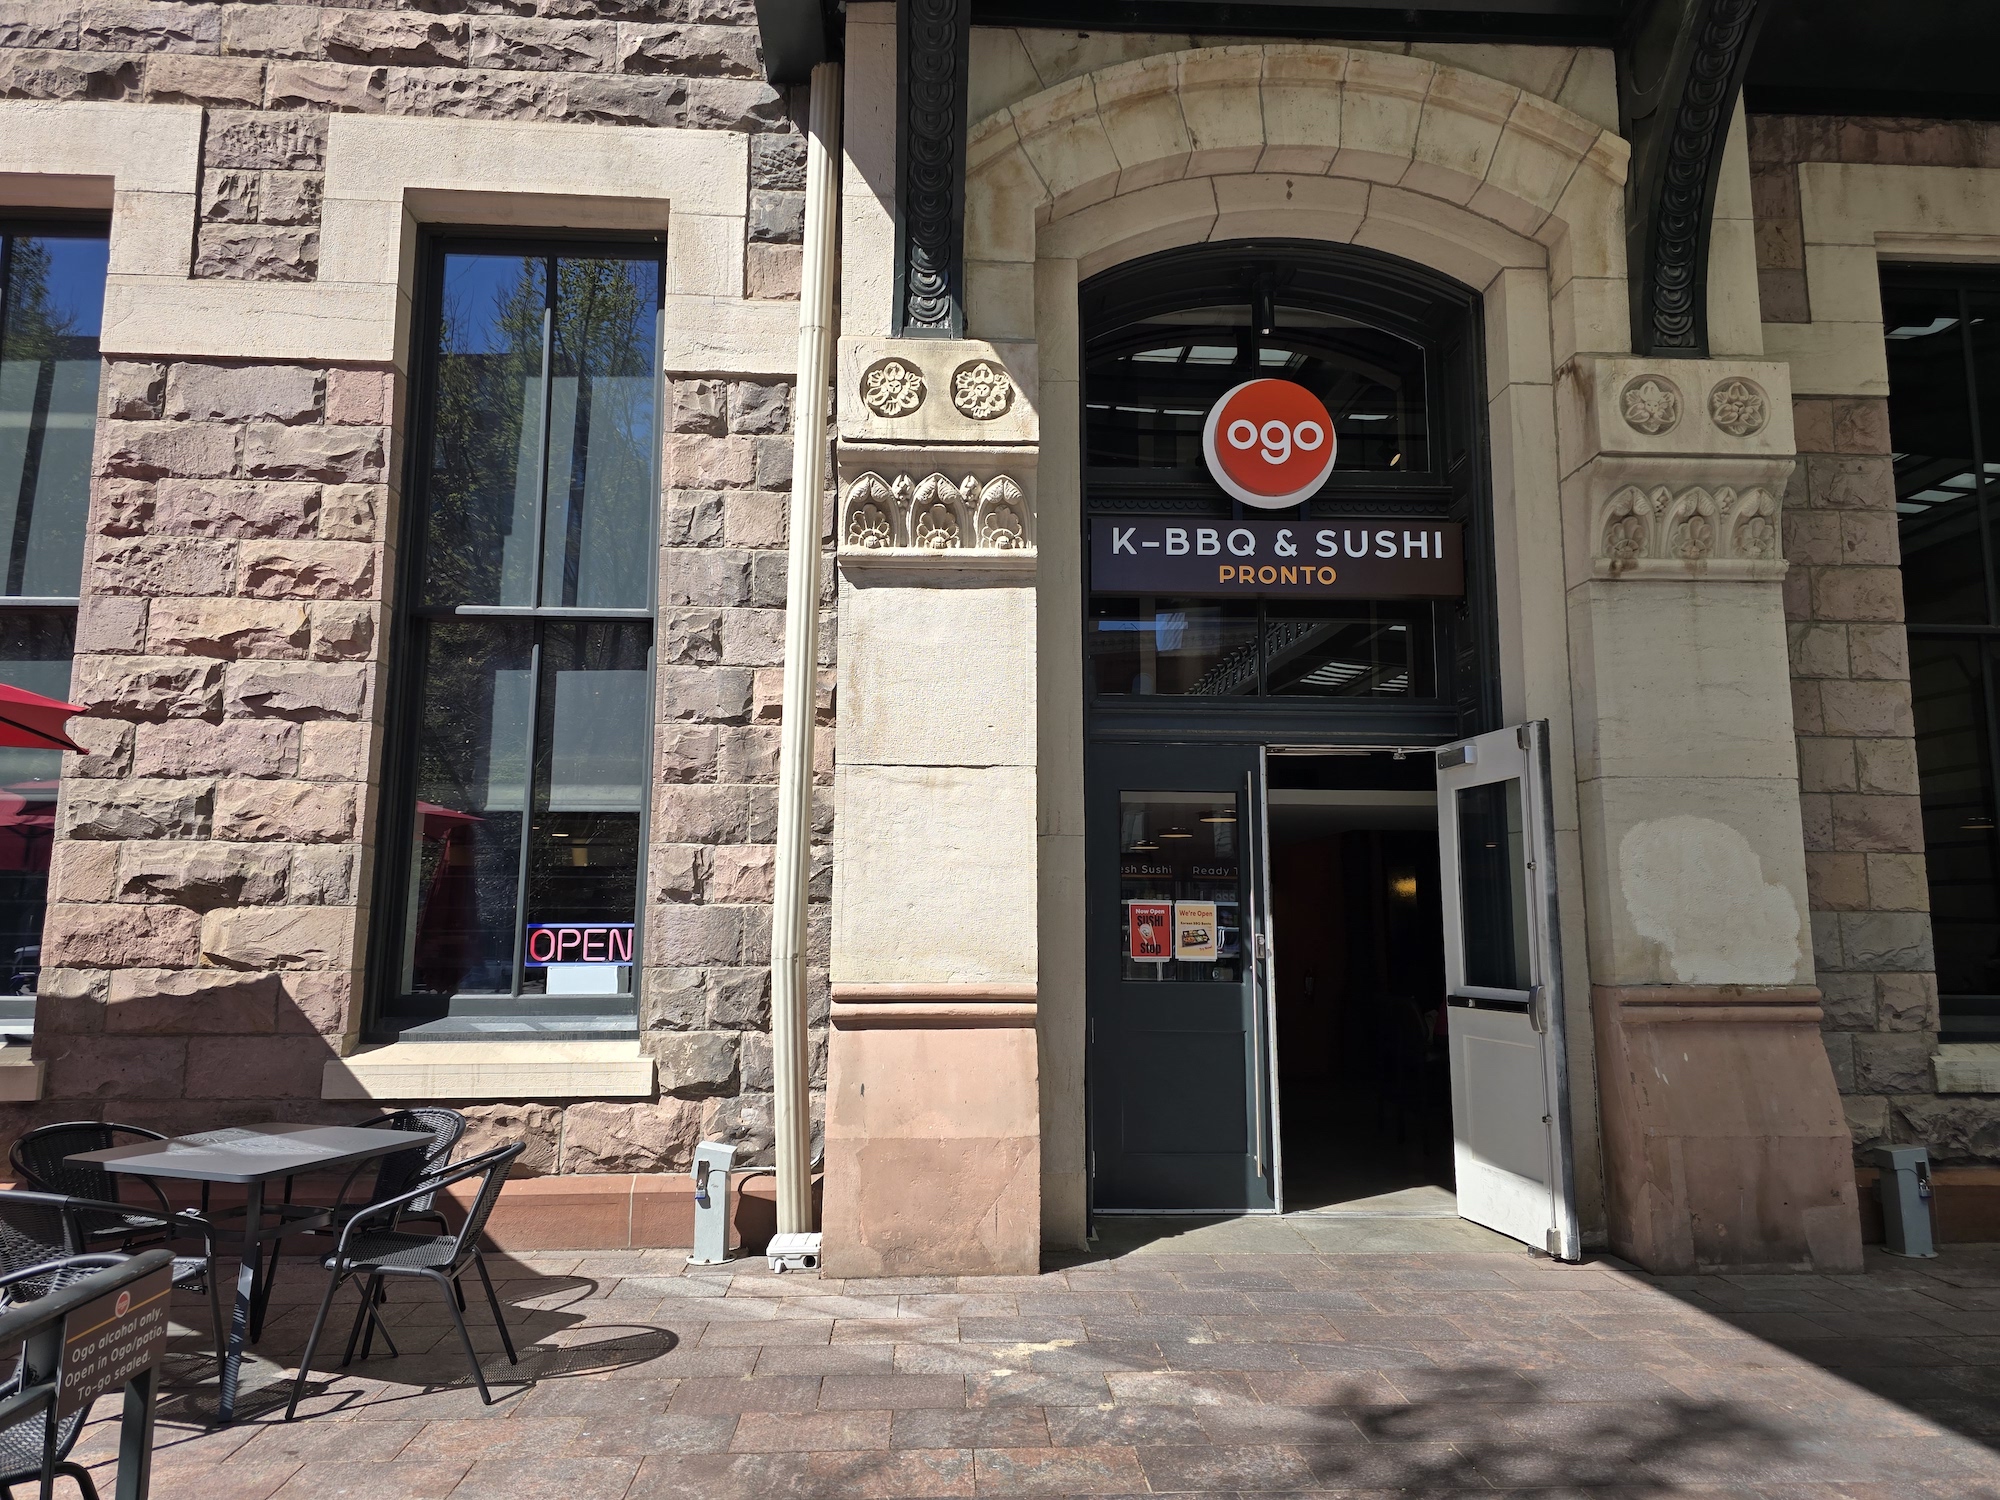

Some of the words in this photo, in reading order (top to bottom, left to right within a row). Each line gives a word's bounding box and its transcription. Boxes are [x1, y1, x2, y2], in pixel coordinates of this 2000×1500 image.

[1227, 419, 1324, 465] ogo
[1112, 526, 1257, 557] K-BBQ
[1274, 528, 1298, 557] &
[1315, 529, 1444, 559] SUSHI
[1219, 564, 1337, 585] PRONTO
[1141, 864, 1172, 874] Sushi
[1192, 865, 1229, 877] Ready
[1137, 915, 1163, 927] SUSHI
[1179, 909, 1196, 917] We're
[1197, 910, 1213, 918] Open
[530, 928, 633, 962] OPEN
[1140, 942, 1161, 955] Stop
[72, 1342, 95, 1363] Ogo
[98, 1317, 138, 1349] alcohol
[139, 1307, 163, 1327] only.
[65, 1363, 94, 1388] Open
[97, 1355, 108, 1371] in
[110, 1325, 165, 1362] Ogo/patio.
[78, 1374, 111, 1401] To-go
[114, 1349, 151, 1380] sealed.
